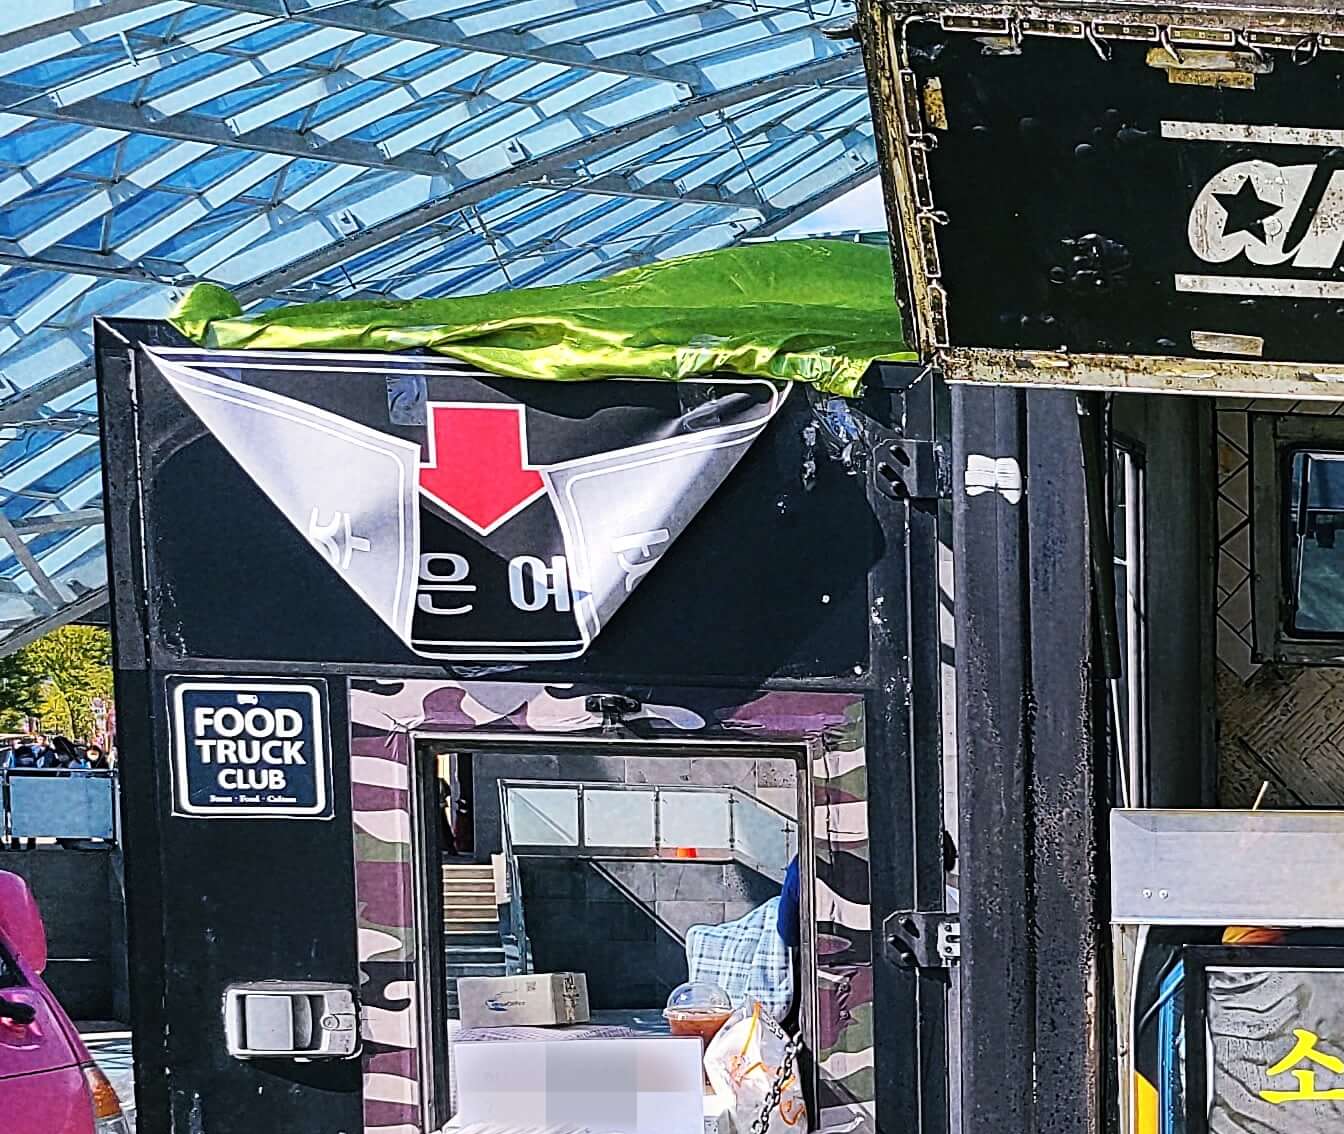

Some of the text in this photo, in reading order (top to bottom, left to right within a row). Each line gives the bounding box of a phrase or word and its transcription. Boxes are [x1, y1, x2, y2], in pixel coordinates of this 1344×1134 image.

[194, 707, 303, 738] FOOD
[194, 739, 307, 765] TRUCK
[217, 768, 286, 790] CLUB
